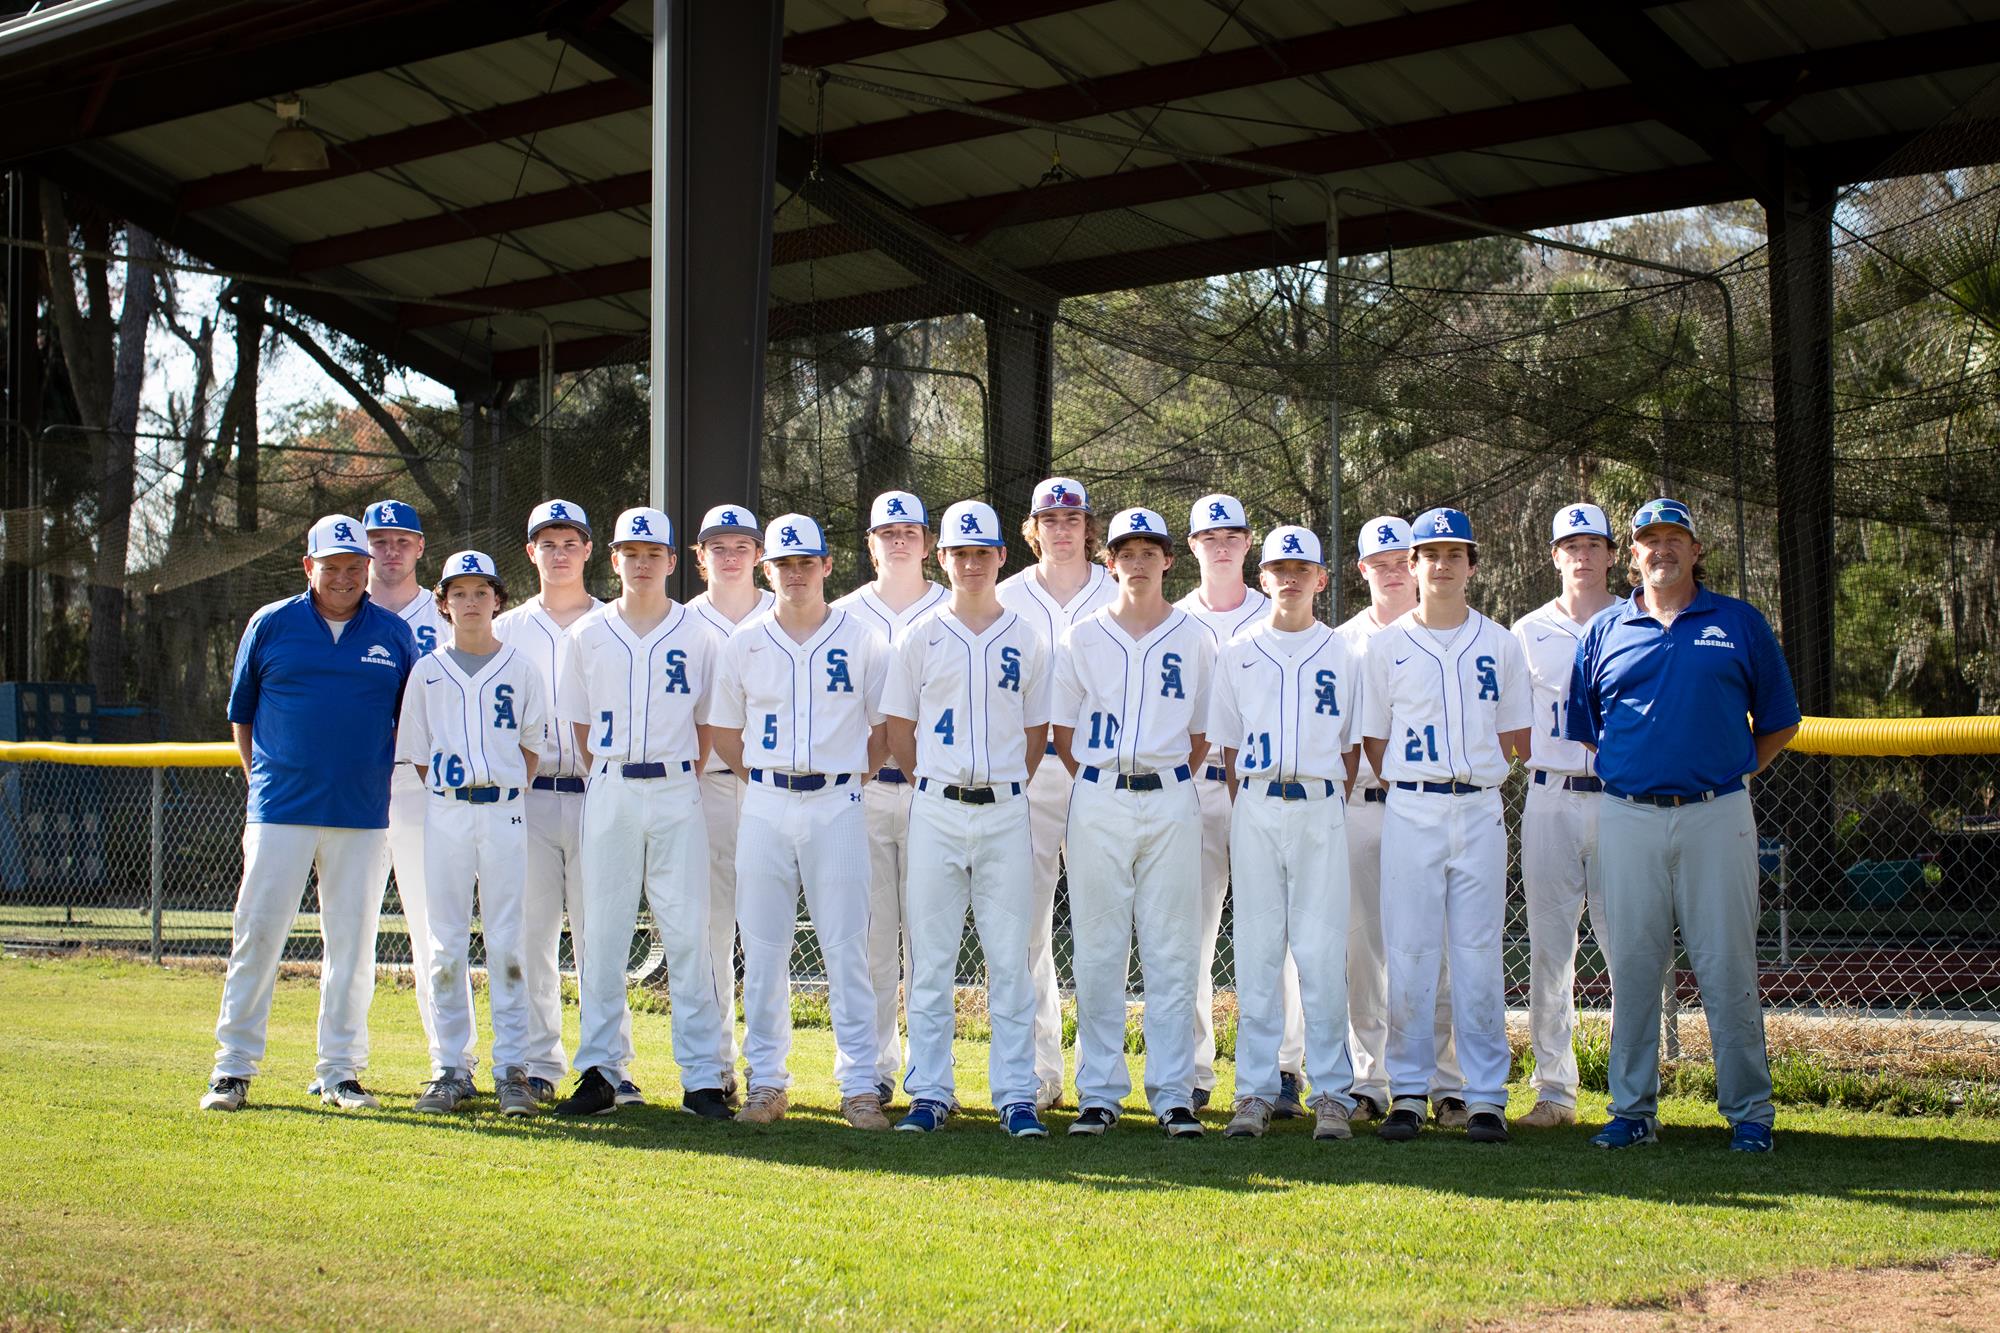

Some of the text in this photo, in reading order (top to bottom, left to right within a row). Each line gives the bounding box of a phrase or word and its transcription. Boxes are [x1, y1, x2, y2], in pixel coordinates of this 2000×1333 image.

[1694, 639, 1735, 649] BASEBALL
[665, 649, 691, 695] SA
[826, 648, 855, 693] SA
[1160, 652, 1186, 700] SA
[1475, 655, 1500, 702] SA
[493, 683, 518, 730] SA
[1314, 669, 1341, 717] SA
[600, 710, 614, 748] 7
[761, 713, 778, 750] 5
[933, 708, 955, 746] 4
[1404, 724, 1439, 763] 21
[432, 751, 465, 788] 16
